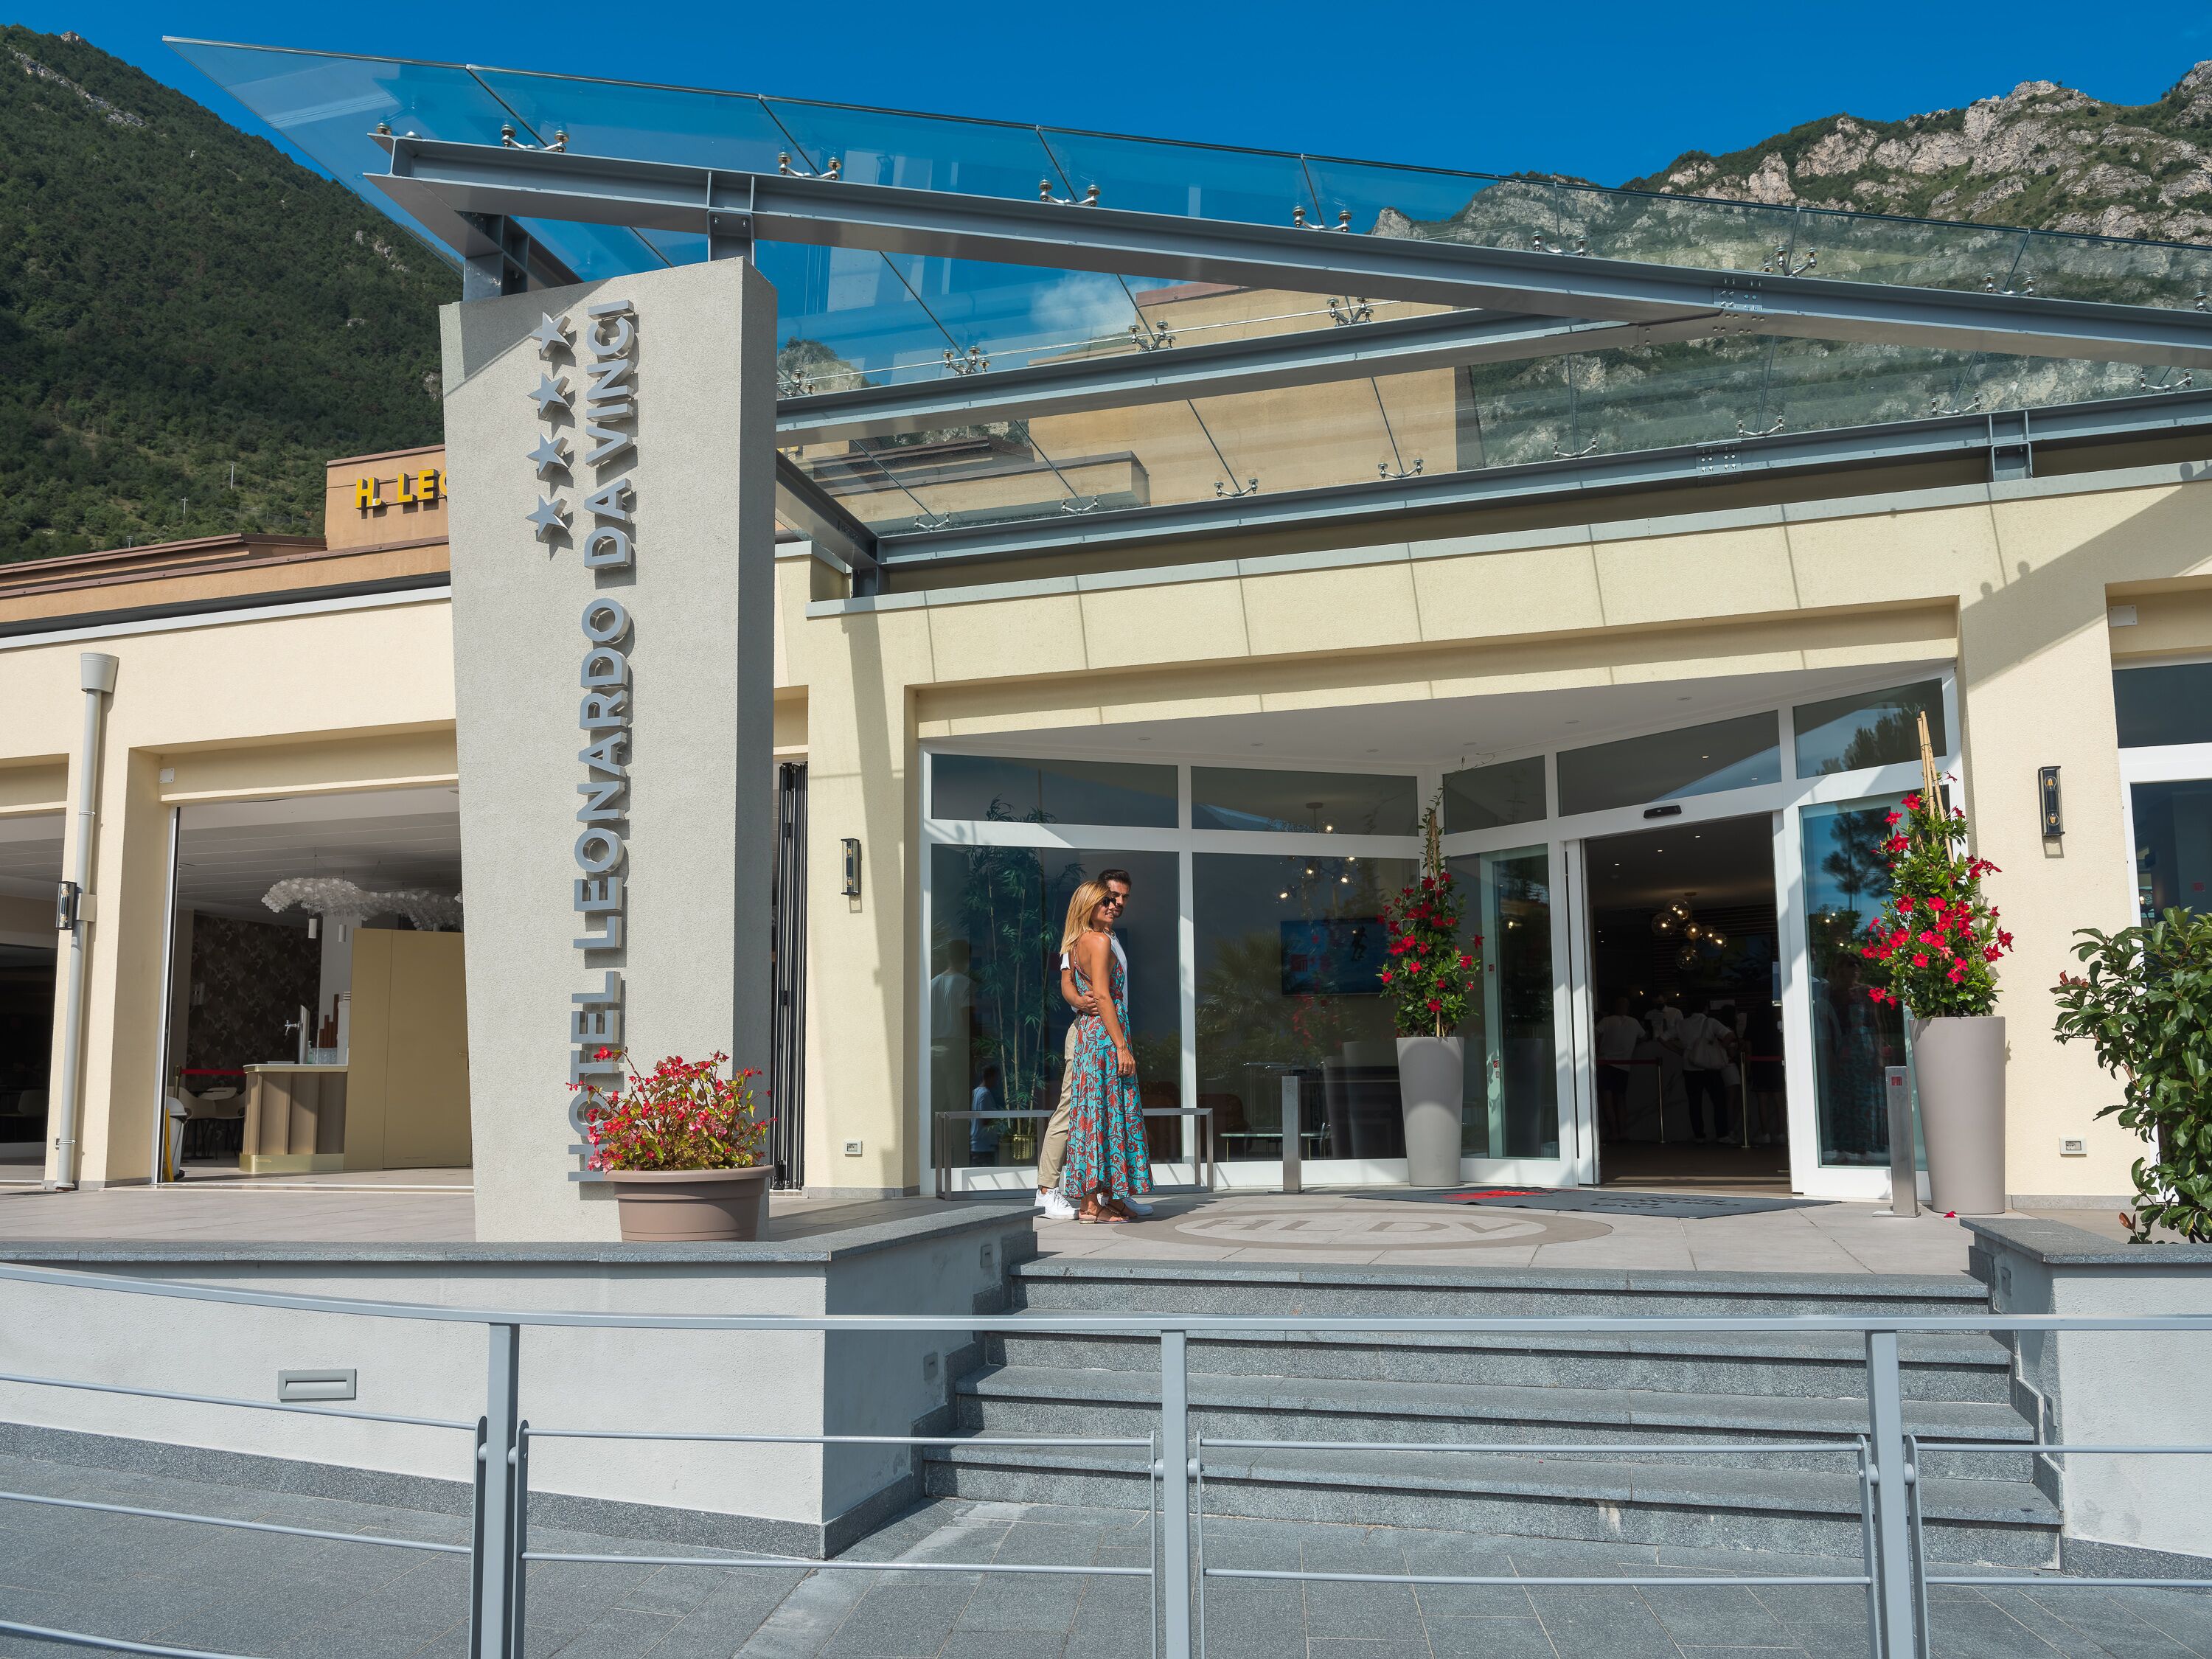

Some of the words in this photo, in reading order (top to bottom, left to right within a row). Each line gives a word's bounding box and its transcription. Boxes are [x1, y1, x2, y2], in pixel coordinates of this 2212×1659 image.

[585, 299, 635, 469] VINCI
[355, 476, 384, 510] H.
[584, 478, 632, 569] DA
[573, 597, 630, 950] LEONARDO
[568, 970, 621, 1182] HOTEL
